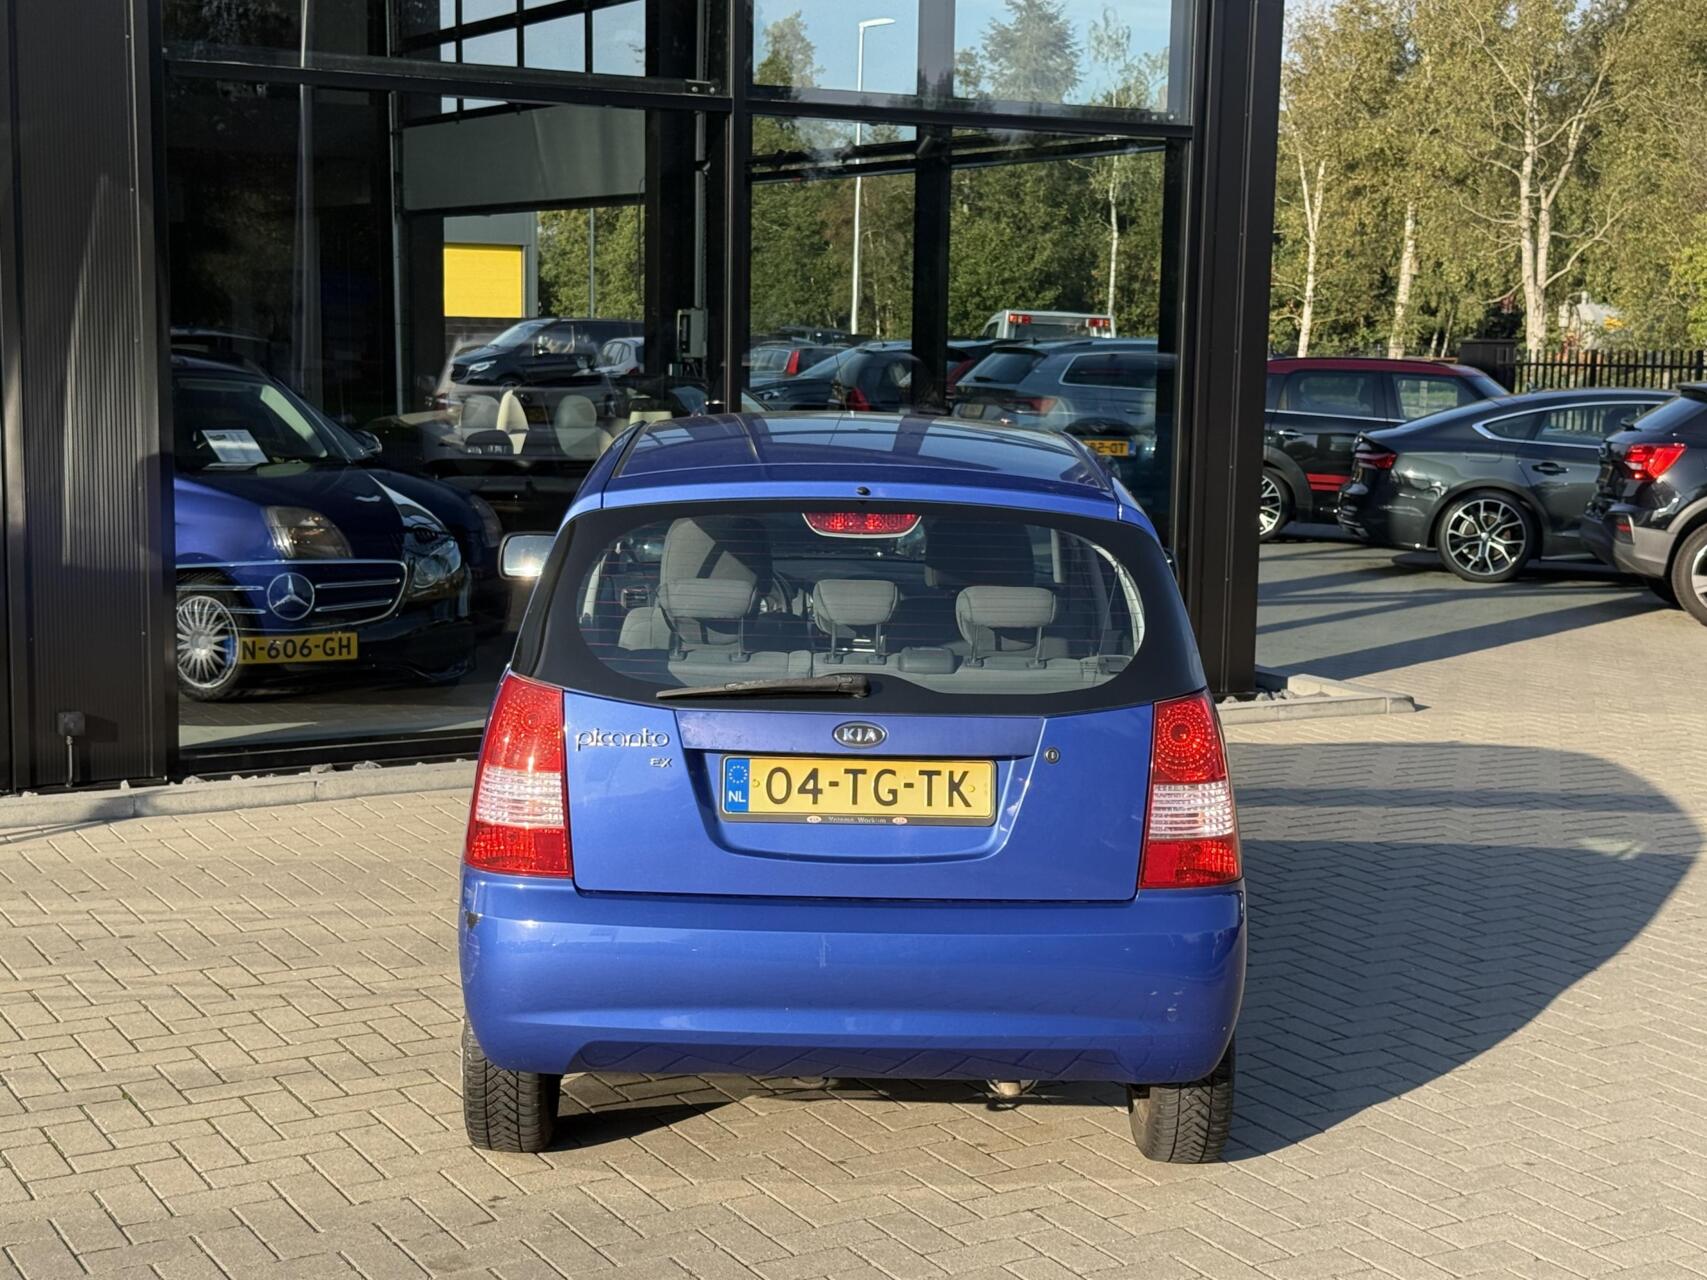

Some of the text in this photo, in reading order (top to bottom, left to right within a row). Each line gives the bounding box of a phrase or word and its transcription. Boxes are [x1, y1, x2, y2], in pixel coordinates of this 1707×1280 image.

[242, 636, 352, 660] N-606-GH
[575, 727, 670, 752] picanto
[843, 727, 878, 742] KIA
[648, 757, 673, 768] EX
[728, 790, 746, 803] NL
[765, 766, 973, 808] 04-TG-TK
